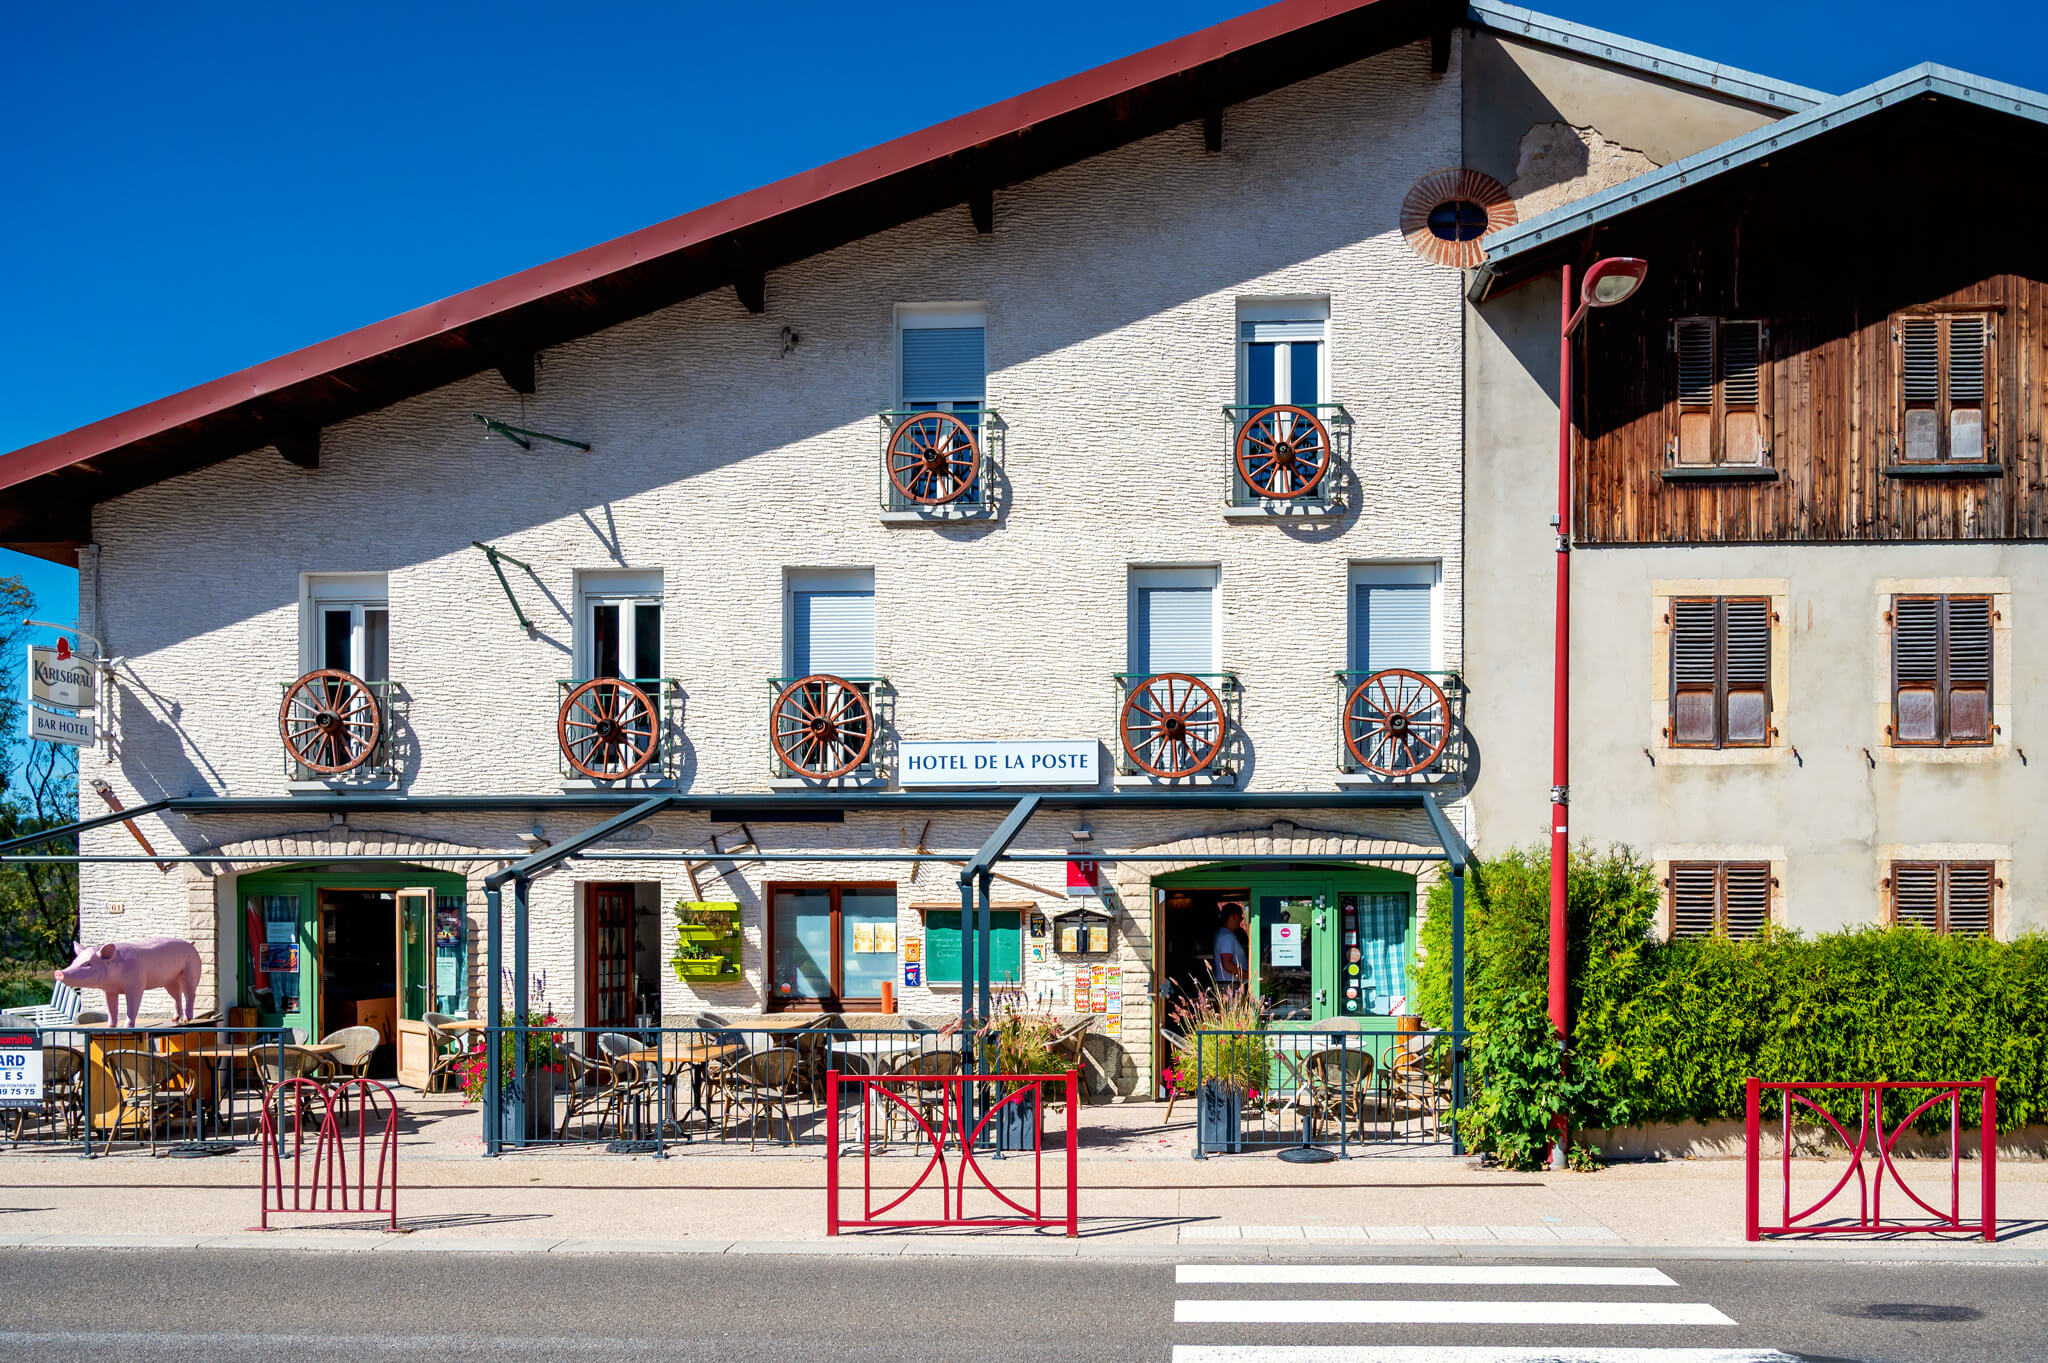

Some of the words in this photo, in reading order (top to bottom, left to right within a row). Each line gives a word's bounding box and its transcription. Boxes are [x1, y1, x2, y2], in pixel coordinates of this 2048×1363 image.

[38, 717, 56, 731] BAR
[59, 721, 89, 736] HOTEL
[908, 755, 968, 770] HOTEL
[975, 755, 998, 770] DE
[1005, 754, 1025, 769] LA
[1031, 753, 1089, 769] POSTE
